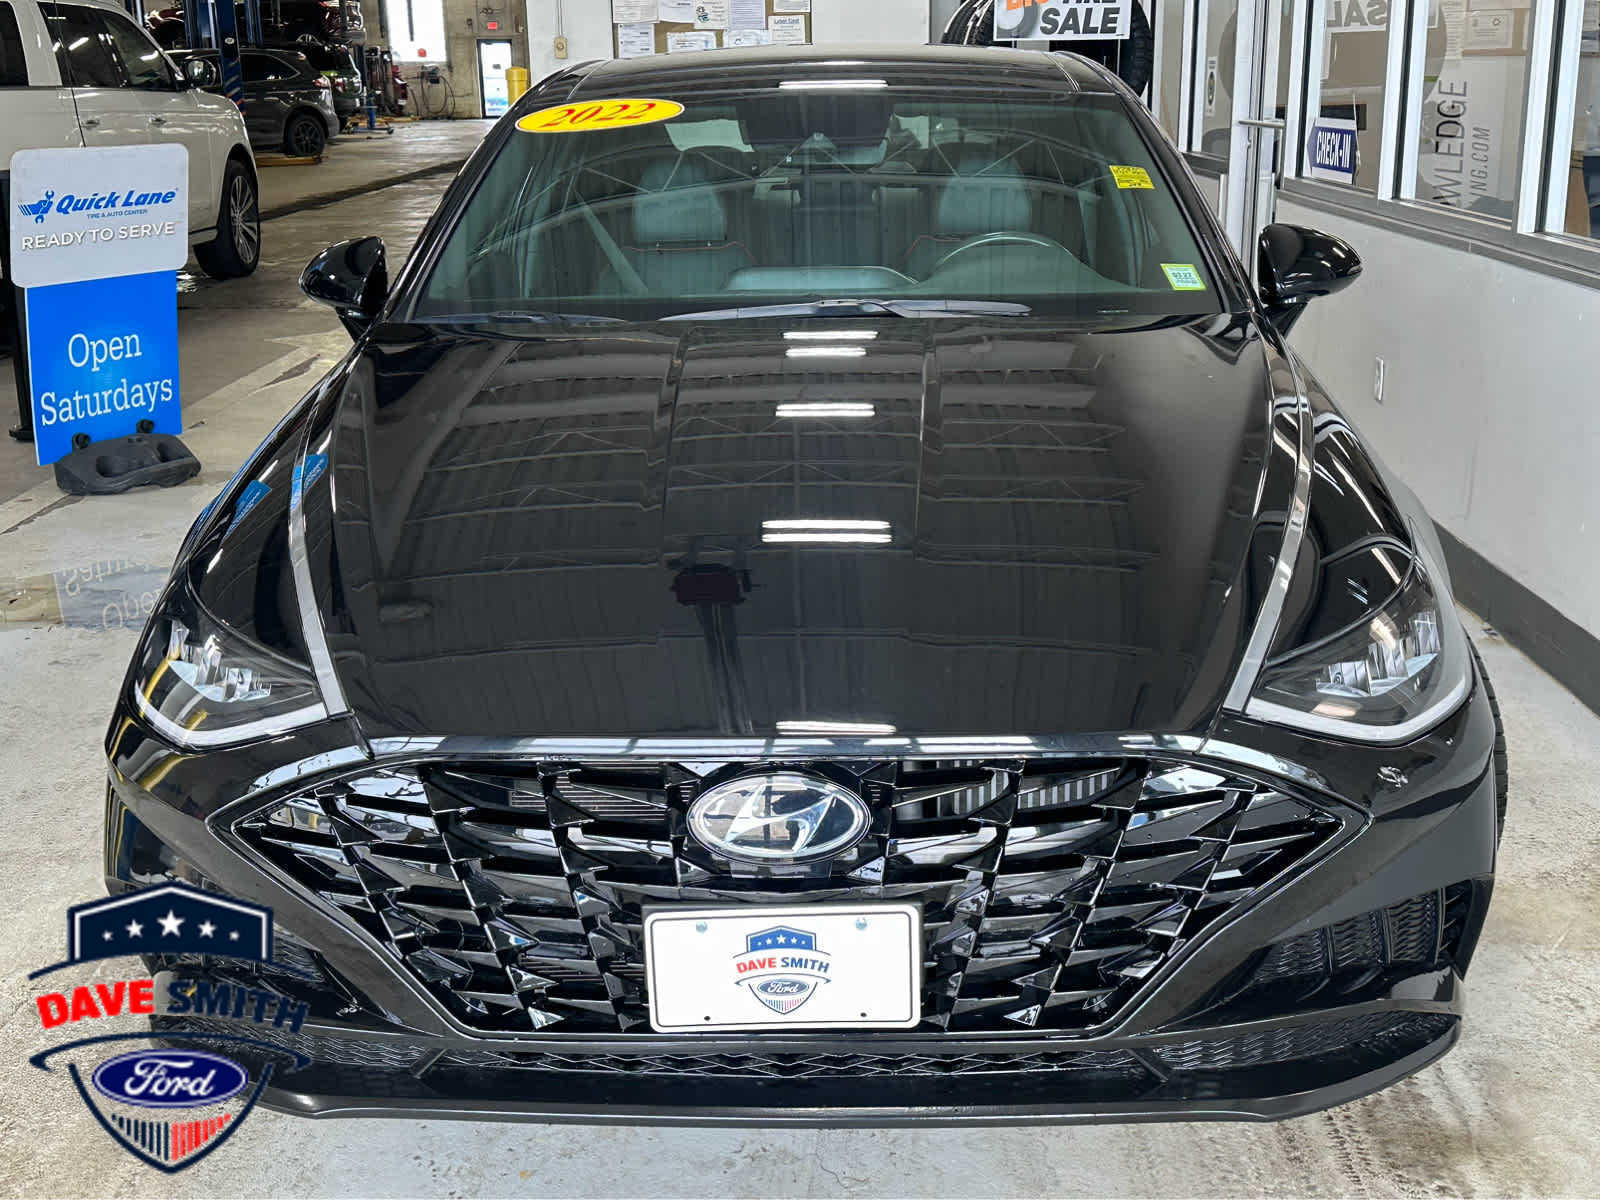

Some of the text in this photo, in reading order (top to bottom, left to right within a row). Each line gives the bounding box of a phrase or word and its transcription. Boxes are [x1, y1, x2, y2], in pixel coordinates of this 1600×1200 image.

[1040, 7, 1120, 35] SALE
[538, 102, 657, 128] 2022
[1432, 79, 1467, 207] WLEDGE
[56, 189, 176, 215] Quick Lane
[124, 208, 149, 216] CENTER
[22, 221, 176, 250] READY TO SERVE
[68, 333, 142, 372] Open
[40, 378, 173, 426] Saturdays
[736, 957, 830, 973] DAVE SMITH
[767, 981, 800, 993] Ford
